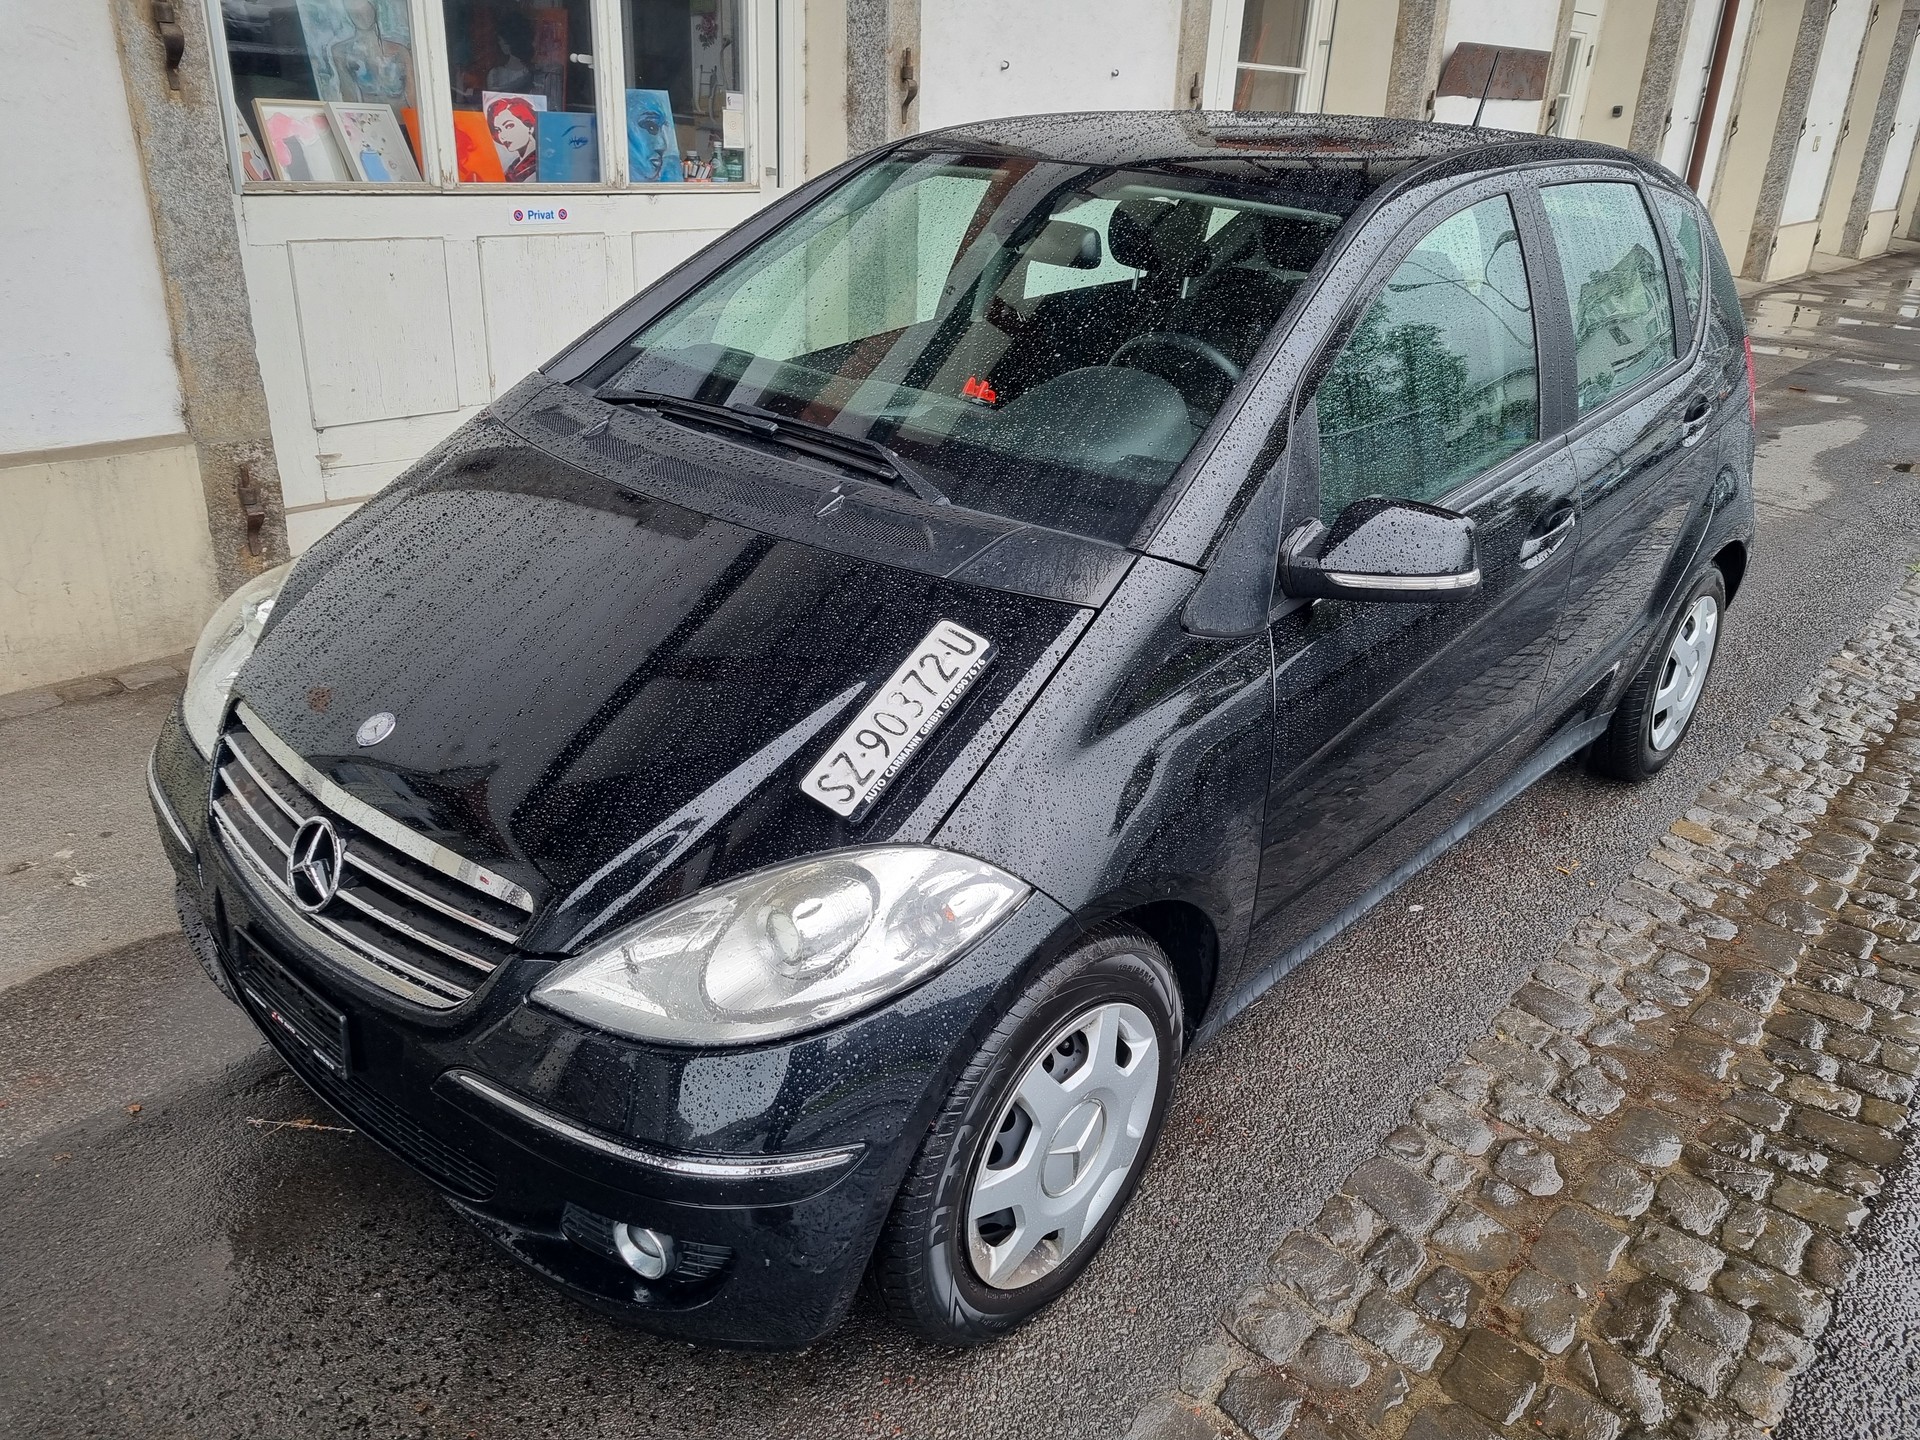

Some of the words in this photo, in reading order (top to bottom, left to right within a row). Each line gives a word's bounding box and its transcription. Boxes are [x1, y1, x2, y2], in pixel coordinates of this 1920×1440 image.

[527, 209, 555, 220] Privat
[864, 779, 887, 804] AUTO
[884, 735, 923, 778] CARMANN
[919, 709, 944, 736] GMBH
[941, 693, 957, 709] 078
[953, 678, 969, 695] 690
[964, 668, 978, 680] 76
[973, 658, 986, 670] 76
